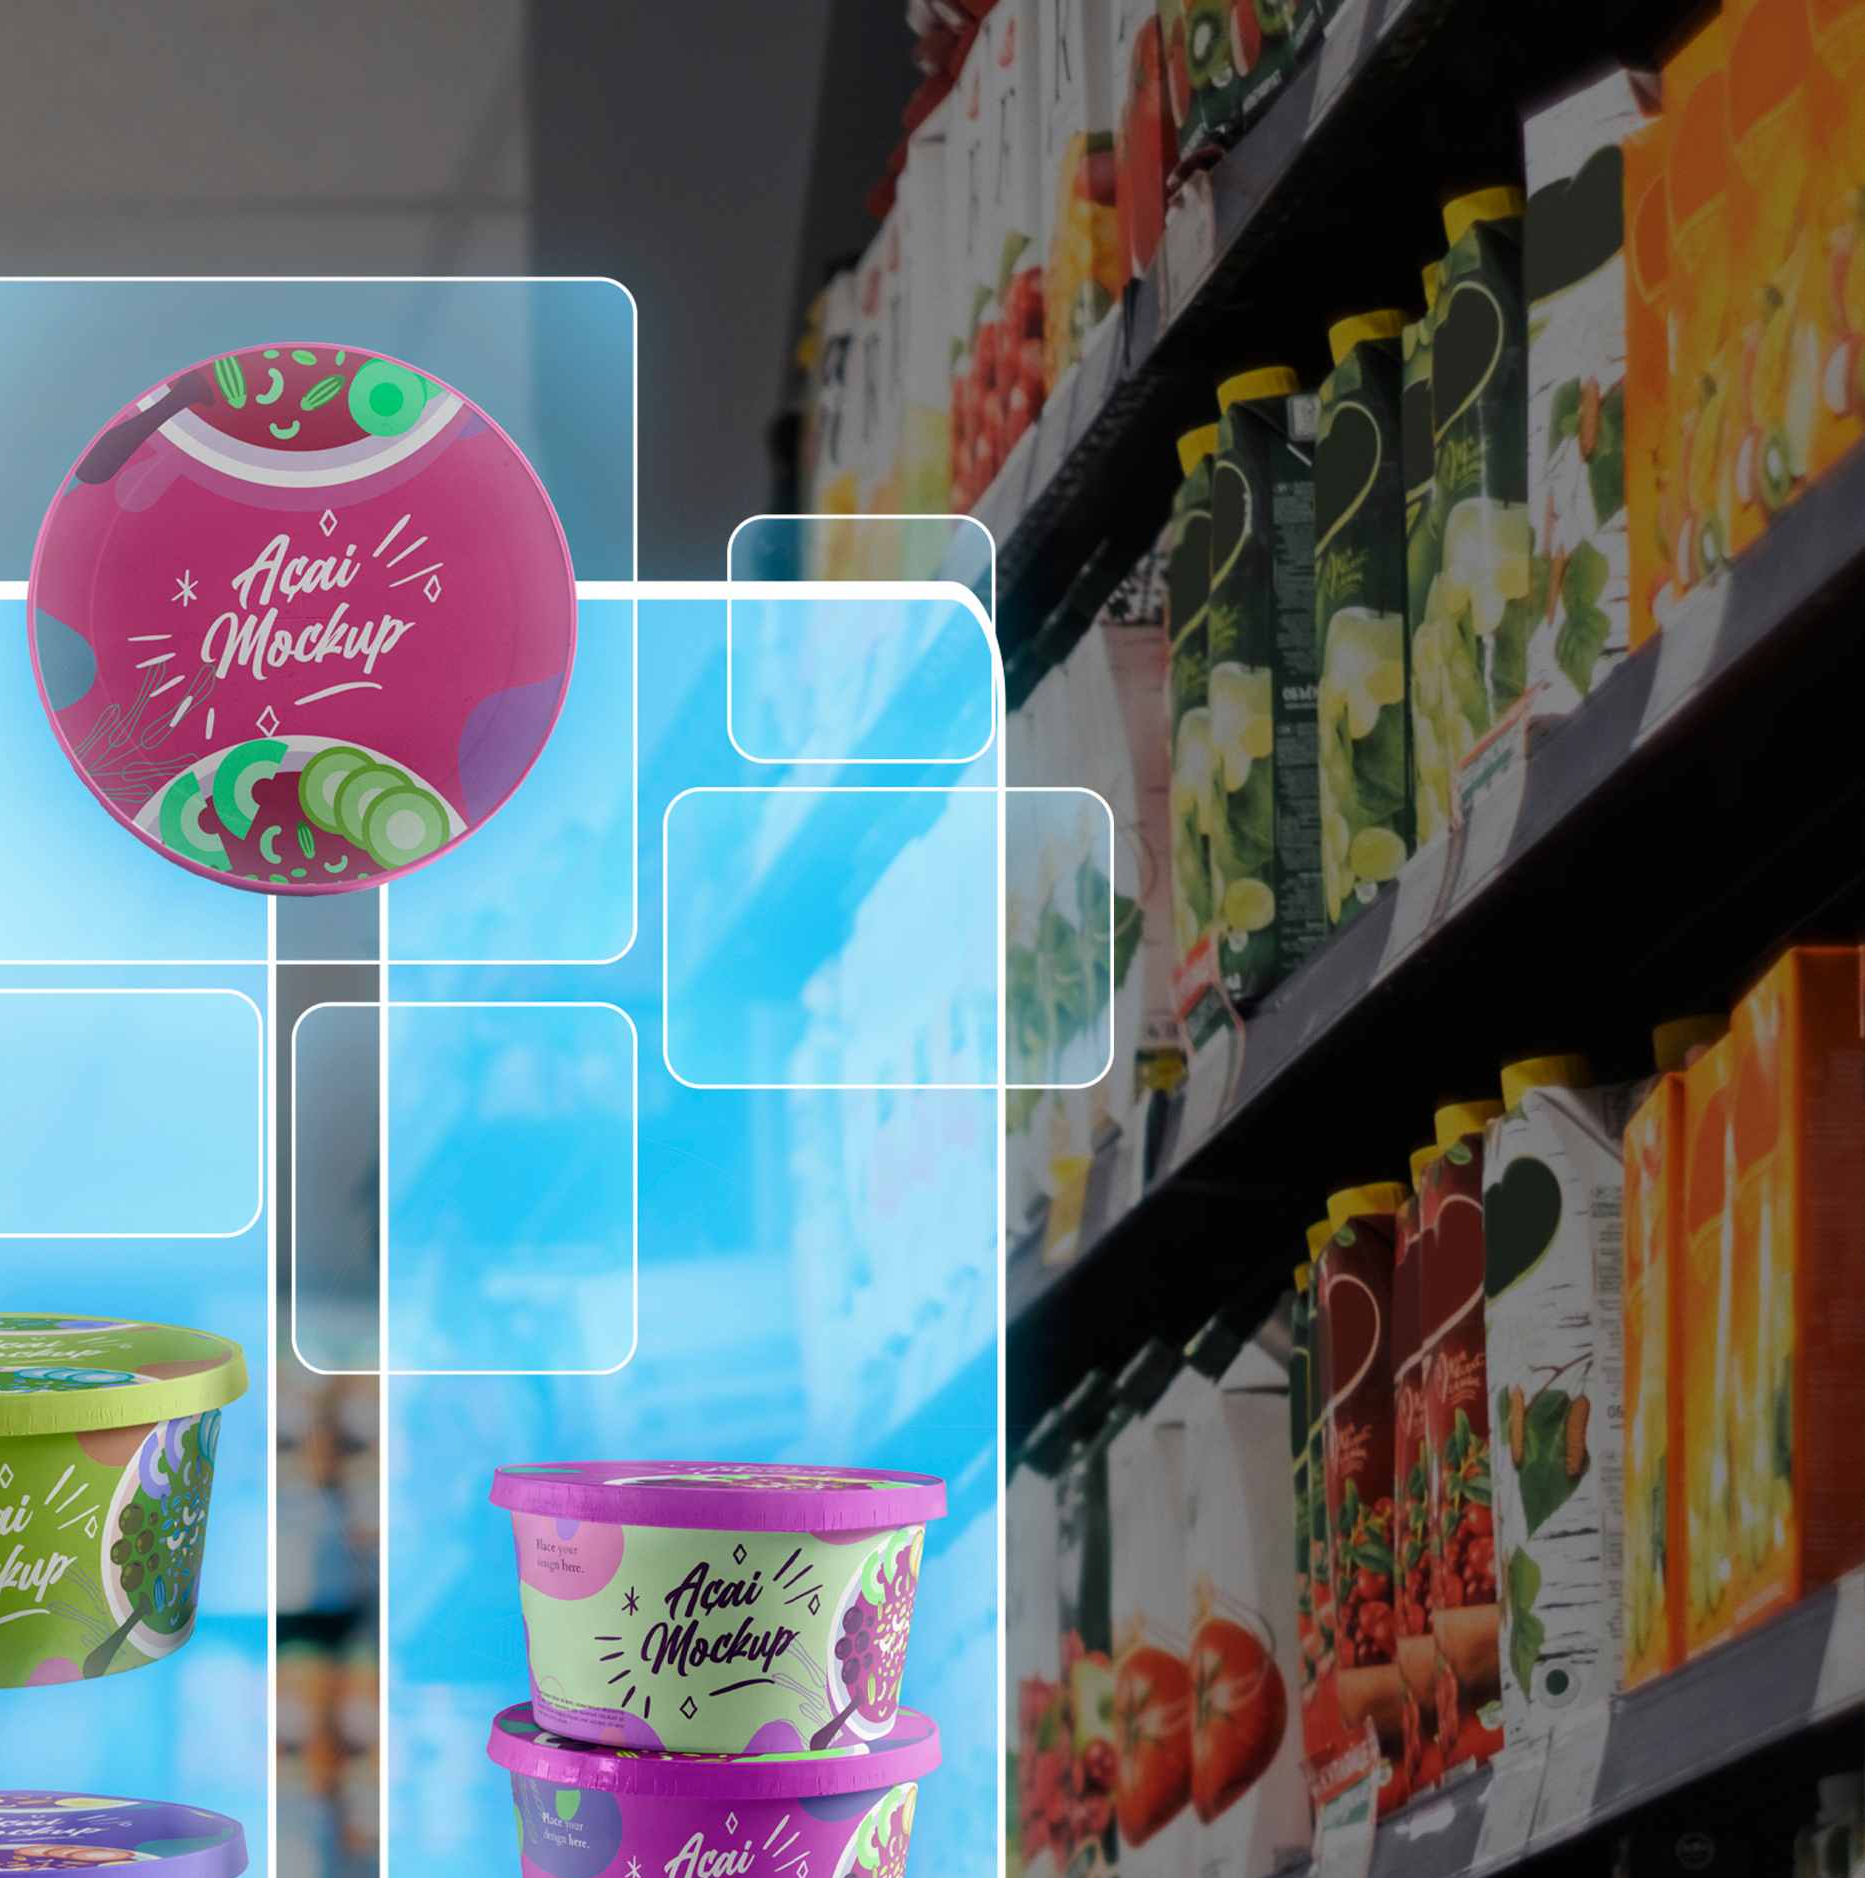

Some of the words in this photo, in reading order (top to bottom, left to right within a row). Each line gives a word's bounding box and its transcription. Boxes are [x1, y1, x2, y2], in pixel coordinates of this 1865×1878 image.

[231, 533, 361, 609] Açai
[200, 602, 416, 681] Mockup
[664, 1562, 764, 1617] Açai
[641, 1616, 800, 1677] Mockup
